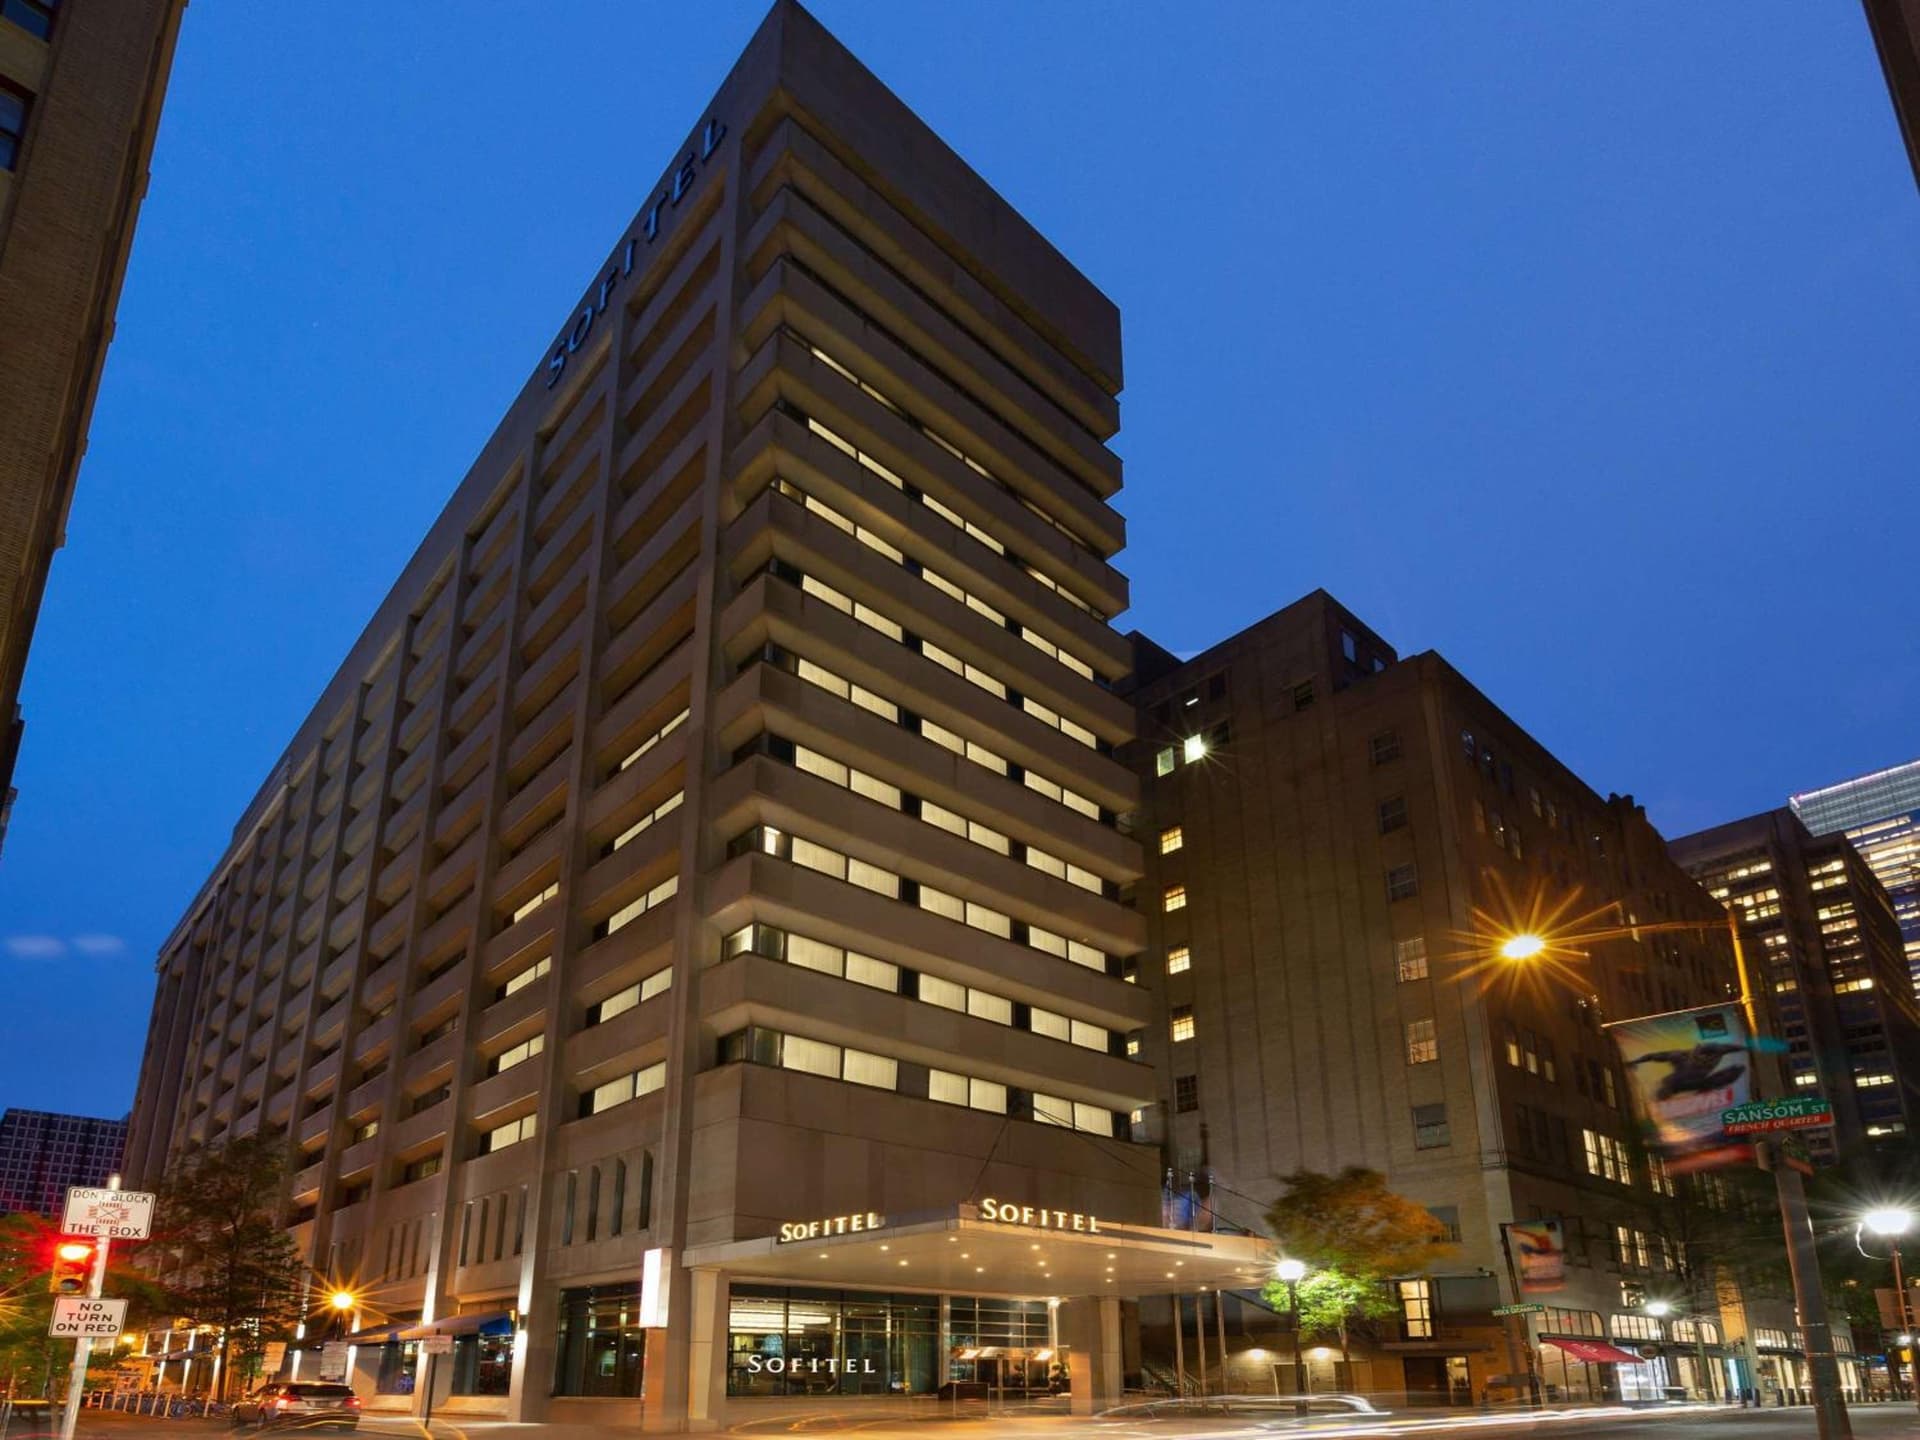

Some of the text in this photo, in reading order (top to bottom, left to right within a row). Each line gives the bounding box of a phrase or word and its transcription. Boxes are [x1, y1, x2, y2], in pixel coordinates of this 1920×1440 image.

[547, 119, 727, 389] SOFITEL
[1725, 1104, 1804, 1124] SANSOM
[1811, 1104, 1826, 1114] ST
[1728, 1120, 1770, 1133] FRENCH
[73, 1189, 150, 1204] DONT BLOCK
[981, 1197, 1101, 1233] SOFITEL
[69, 1223, 142, 1237] THE BOX
[780, 1211, 879, 1244] SOFITEL
[79, 1303, 103, 1312] NO
[67, 1312, 113, 1322] TURN
[55, 1323, 118, 1333] ON RED
[747, 1354, 877, 1375] SOFITEL
